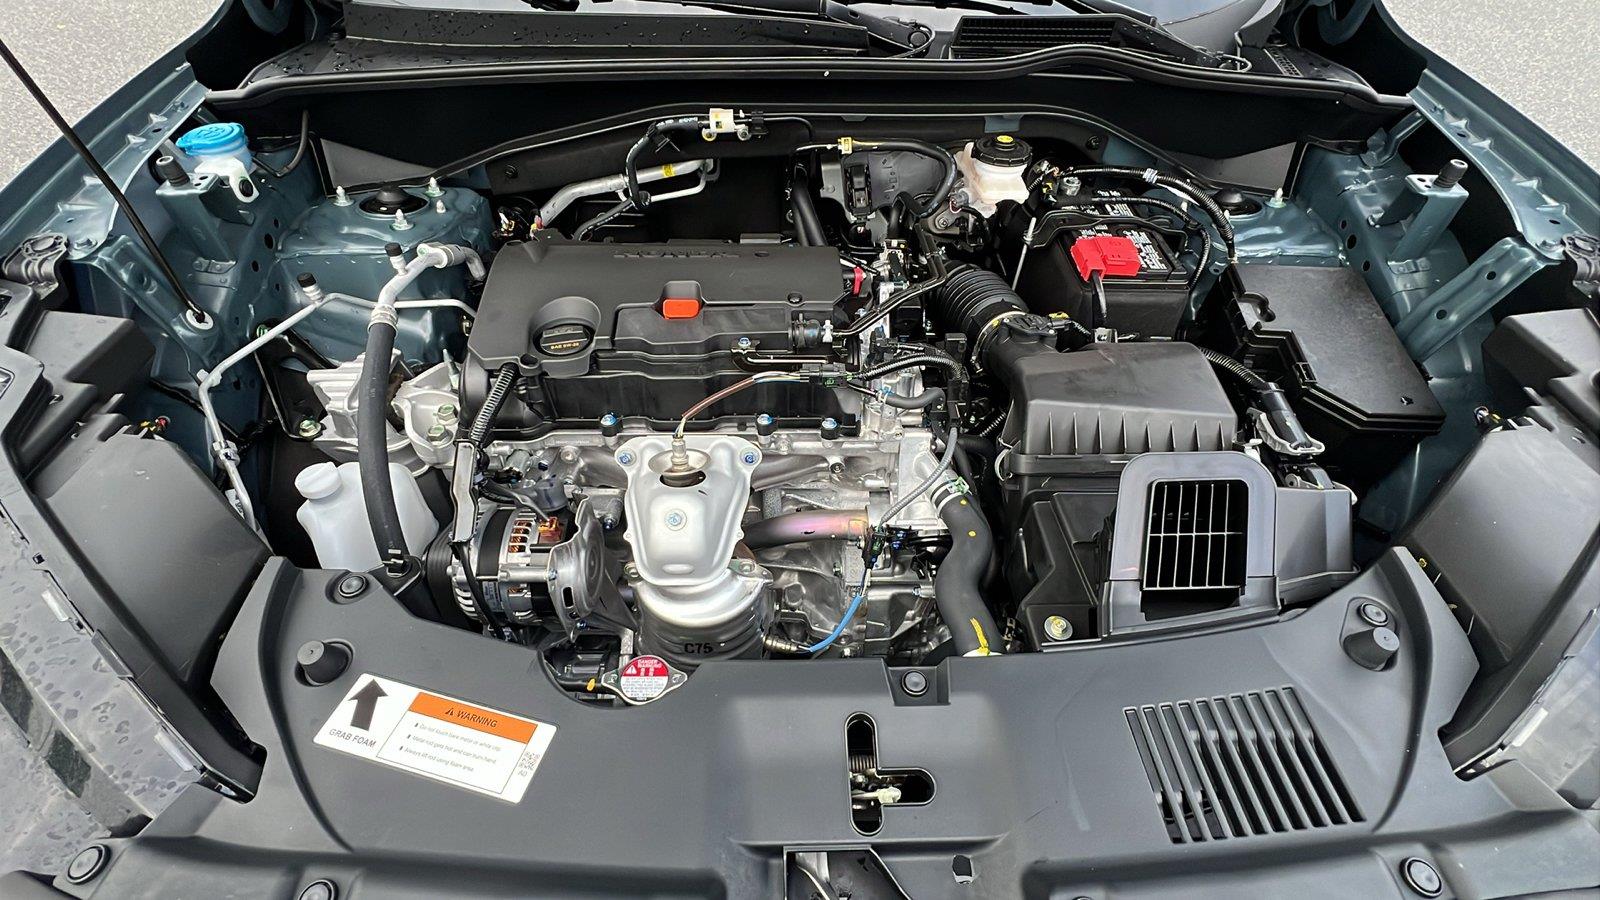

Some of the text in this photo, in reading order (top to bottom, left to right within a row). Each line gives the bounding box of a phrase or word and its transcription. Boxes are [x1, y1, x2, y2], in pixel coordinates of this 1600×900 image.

[684, 642, 713, 654] C75
[456, 710, 498, 728] WARNING
[329, 728, 377, 748] GRAB FOAM
